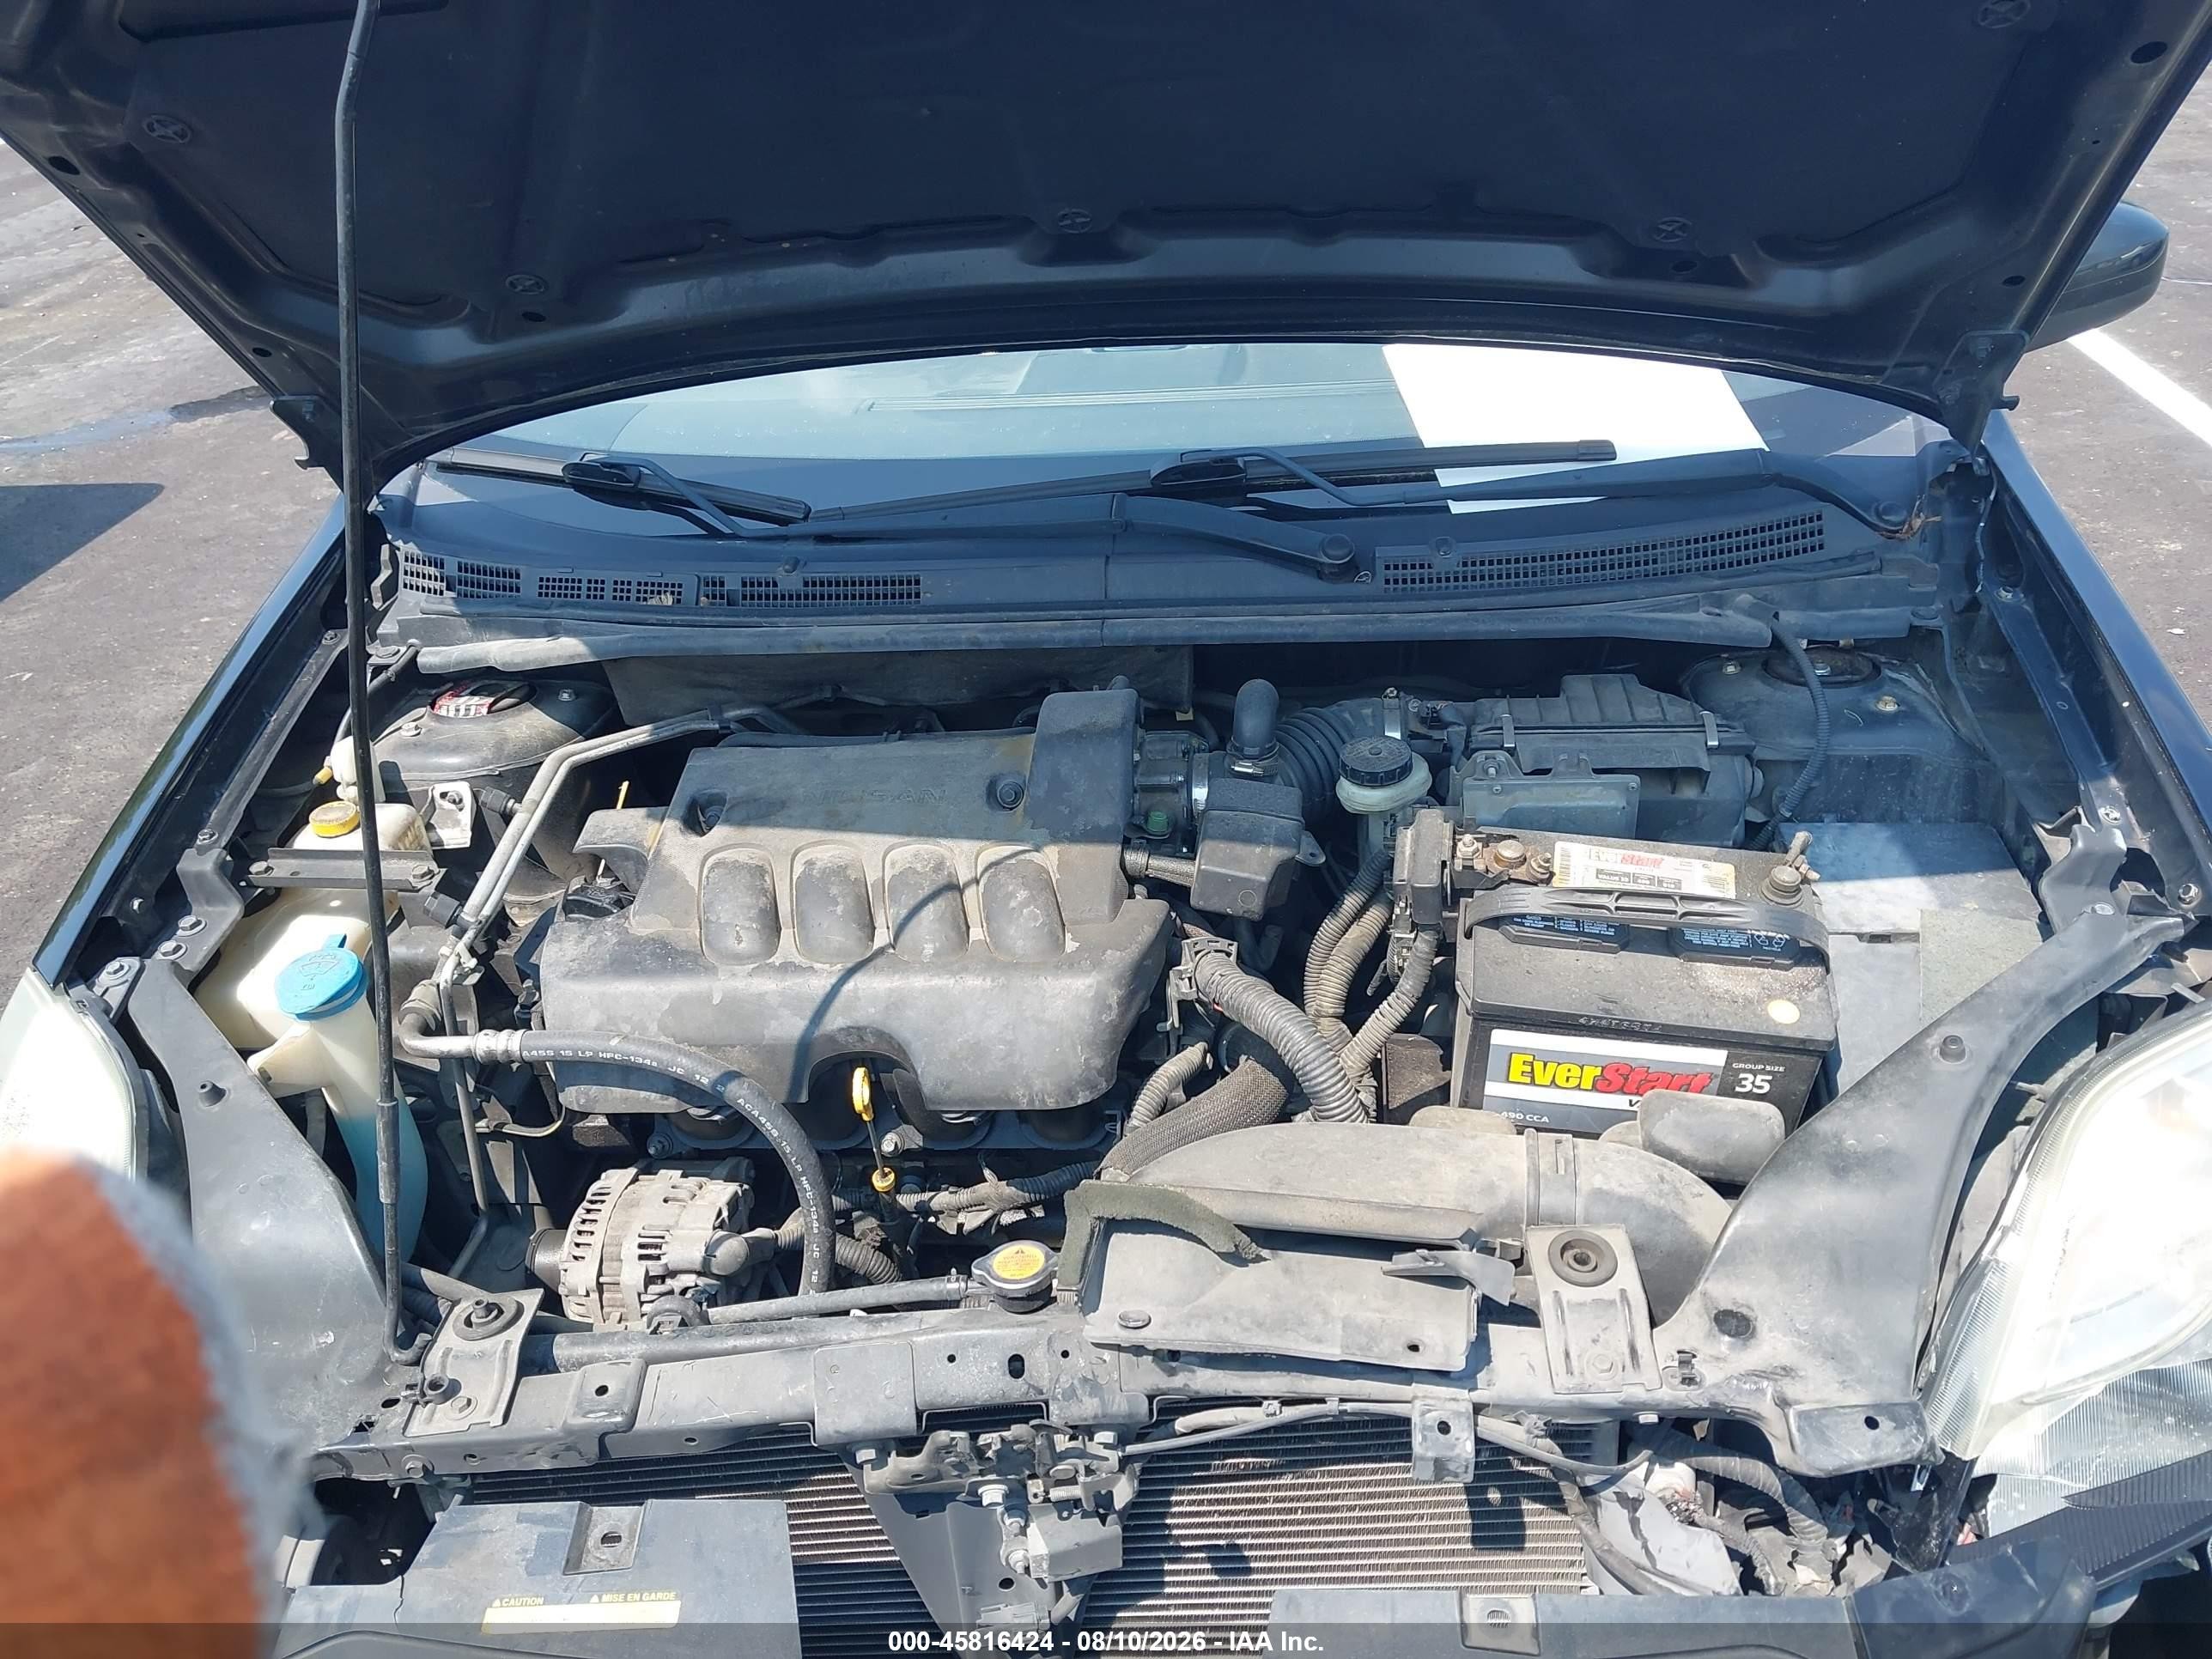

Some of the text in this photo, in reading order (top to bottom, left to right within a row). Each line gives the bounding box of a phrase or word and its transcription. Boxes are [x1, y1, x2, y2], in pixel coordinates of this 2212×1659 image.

[1508, 1052, 1713, 1096] EverStart
[1735, 1073, 1773, 1094] 35
[1525, 1114, 1550, 1123] CCA
[501, 1597, 544, 1607] CAUTION
[601, 1592, 677, 1603] MISE EN GARDE
